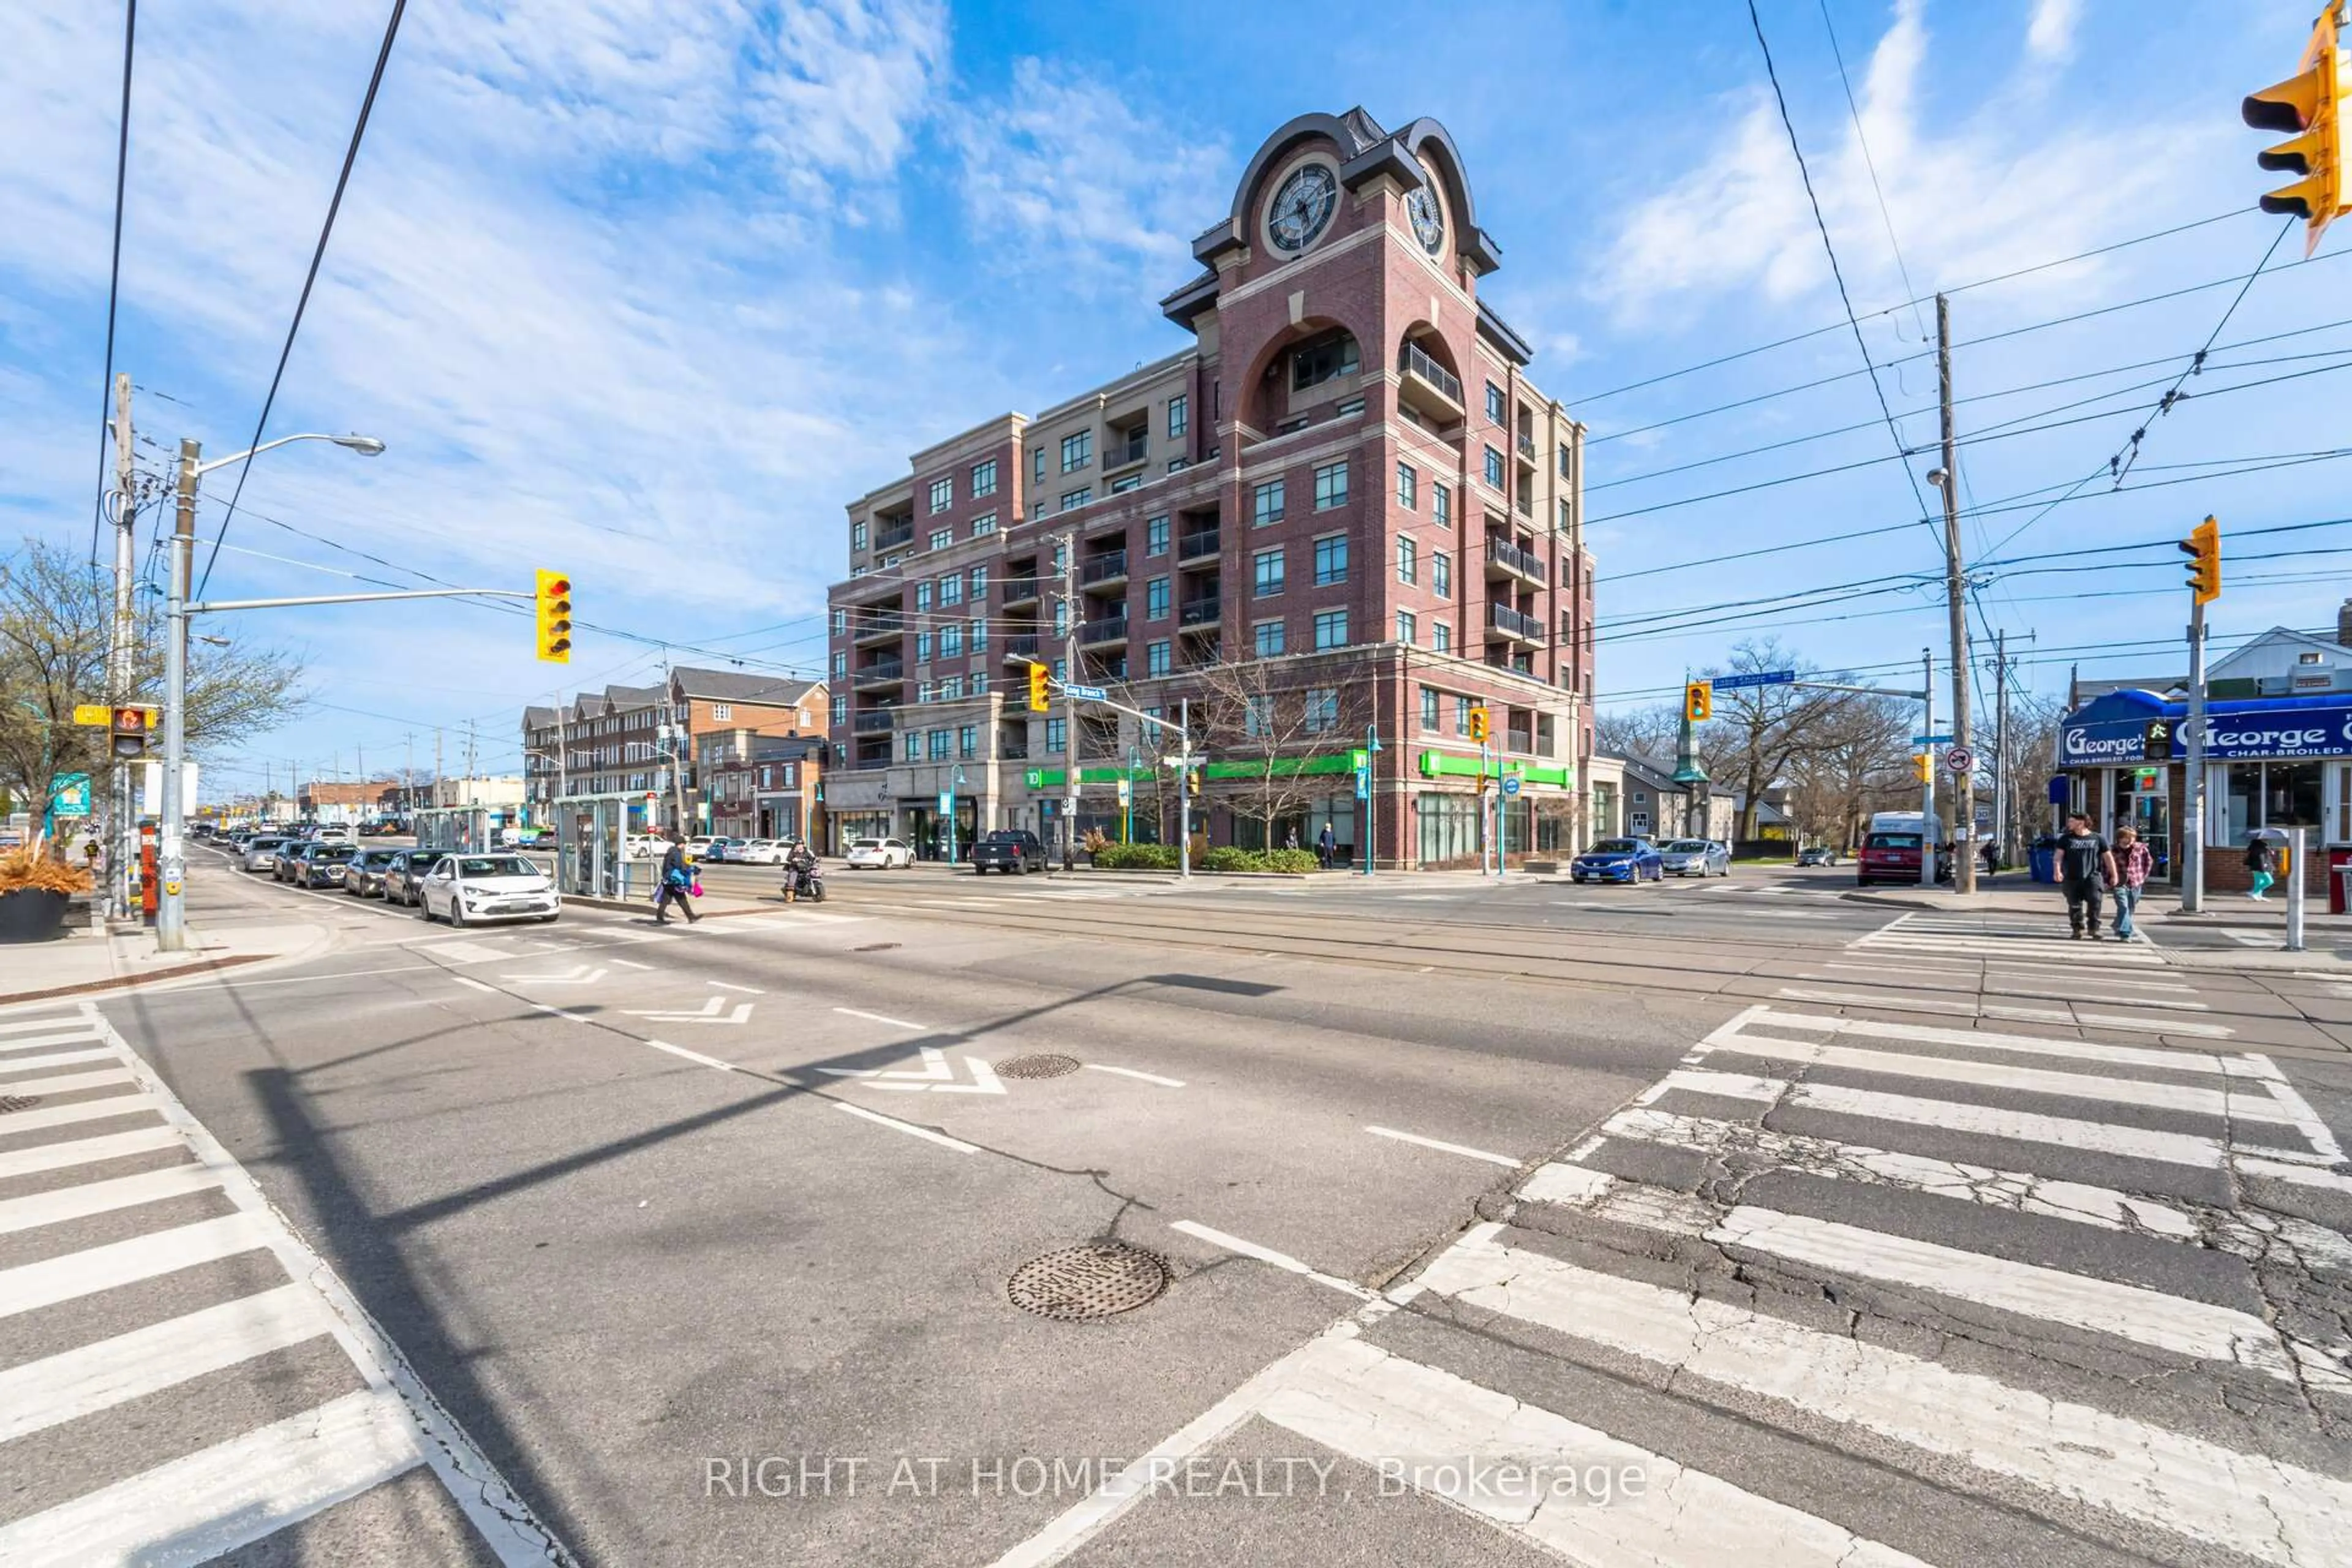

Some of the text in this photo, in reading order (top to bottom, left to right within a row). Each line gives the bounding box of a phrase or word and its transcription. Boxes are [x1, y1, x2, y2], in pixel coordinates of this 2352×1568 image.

[1738, 676, 1766, 685] Shore
[2176, 718, 2326, 748] George
[2227, 747, 2343, 757] CHAR-BROILED
